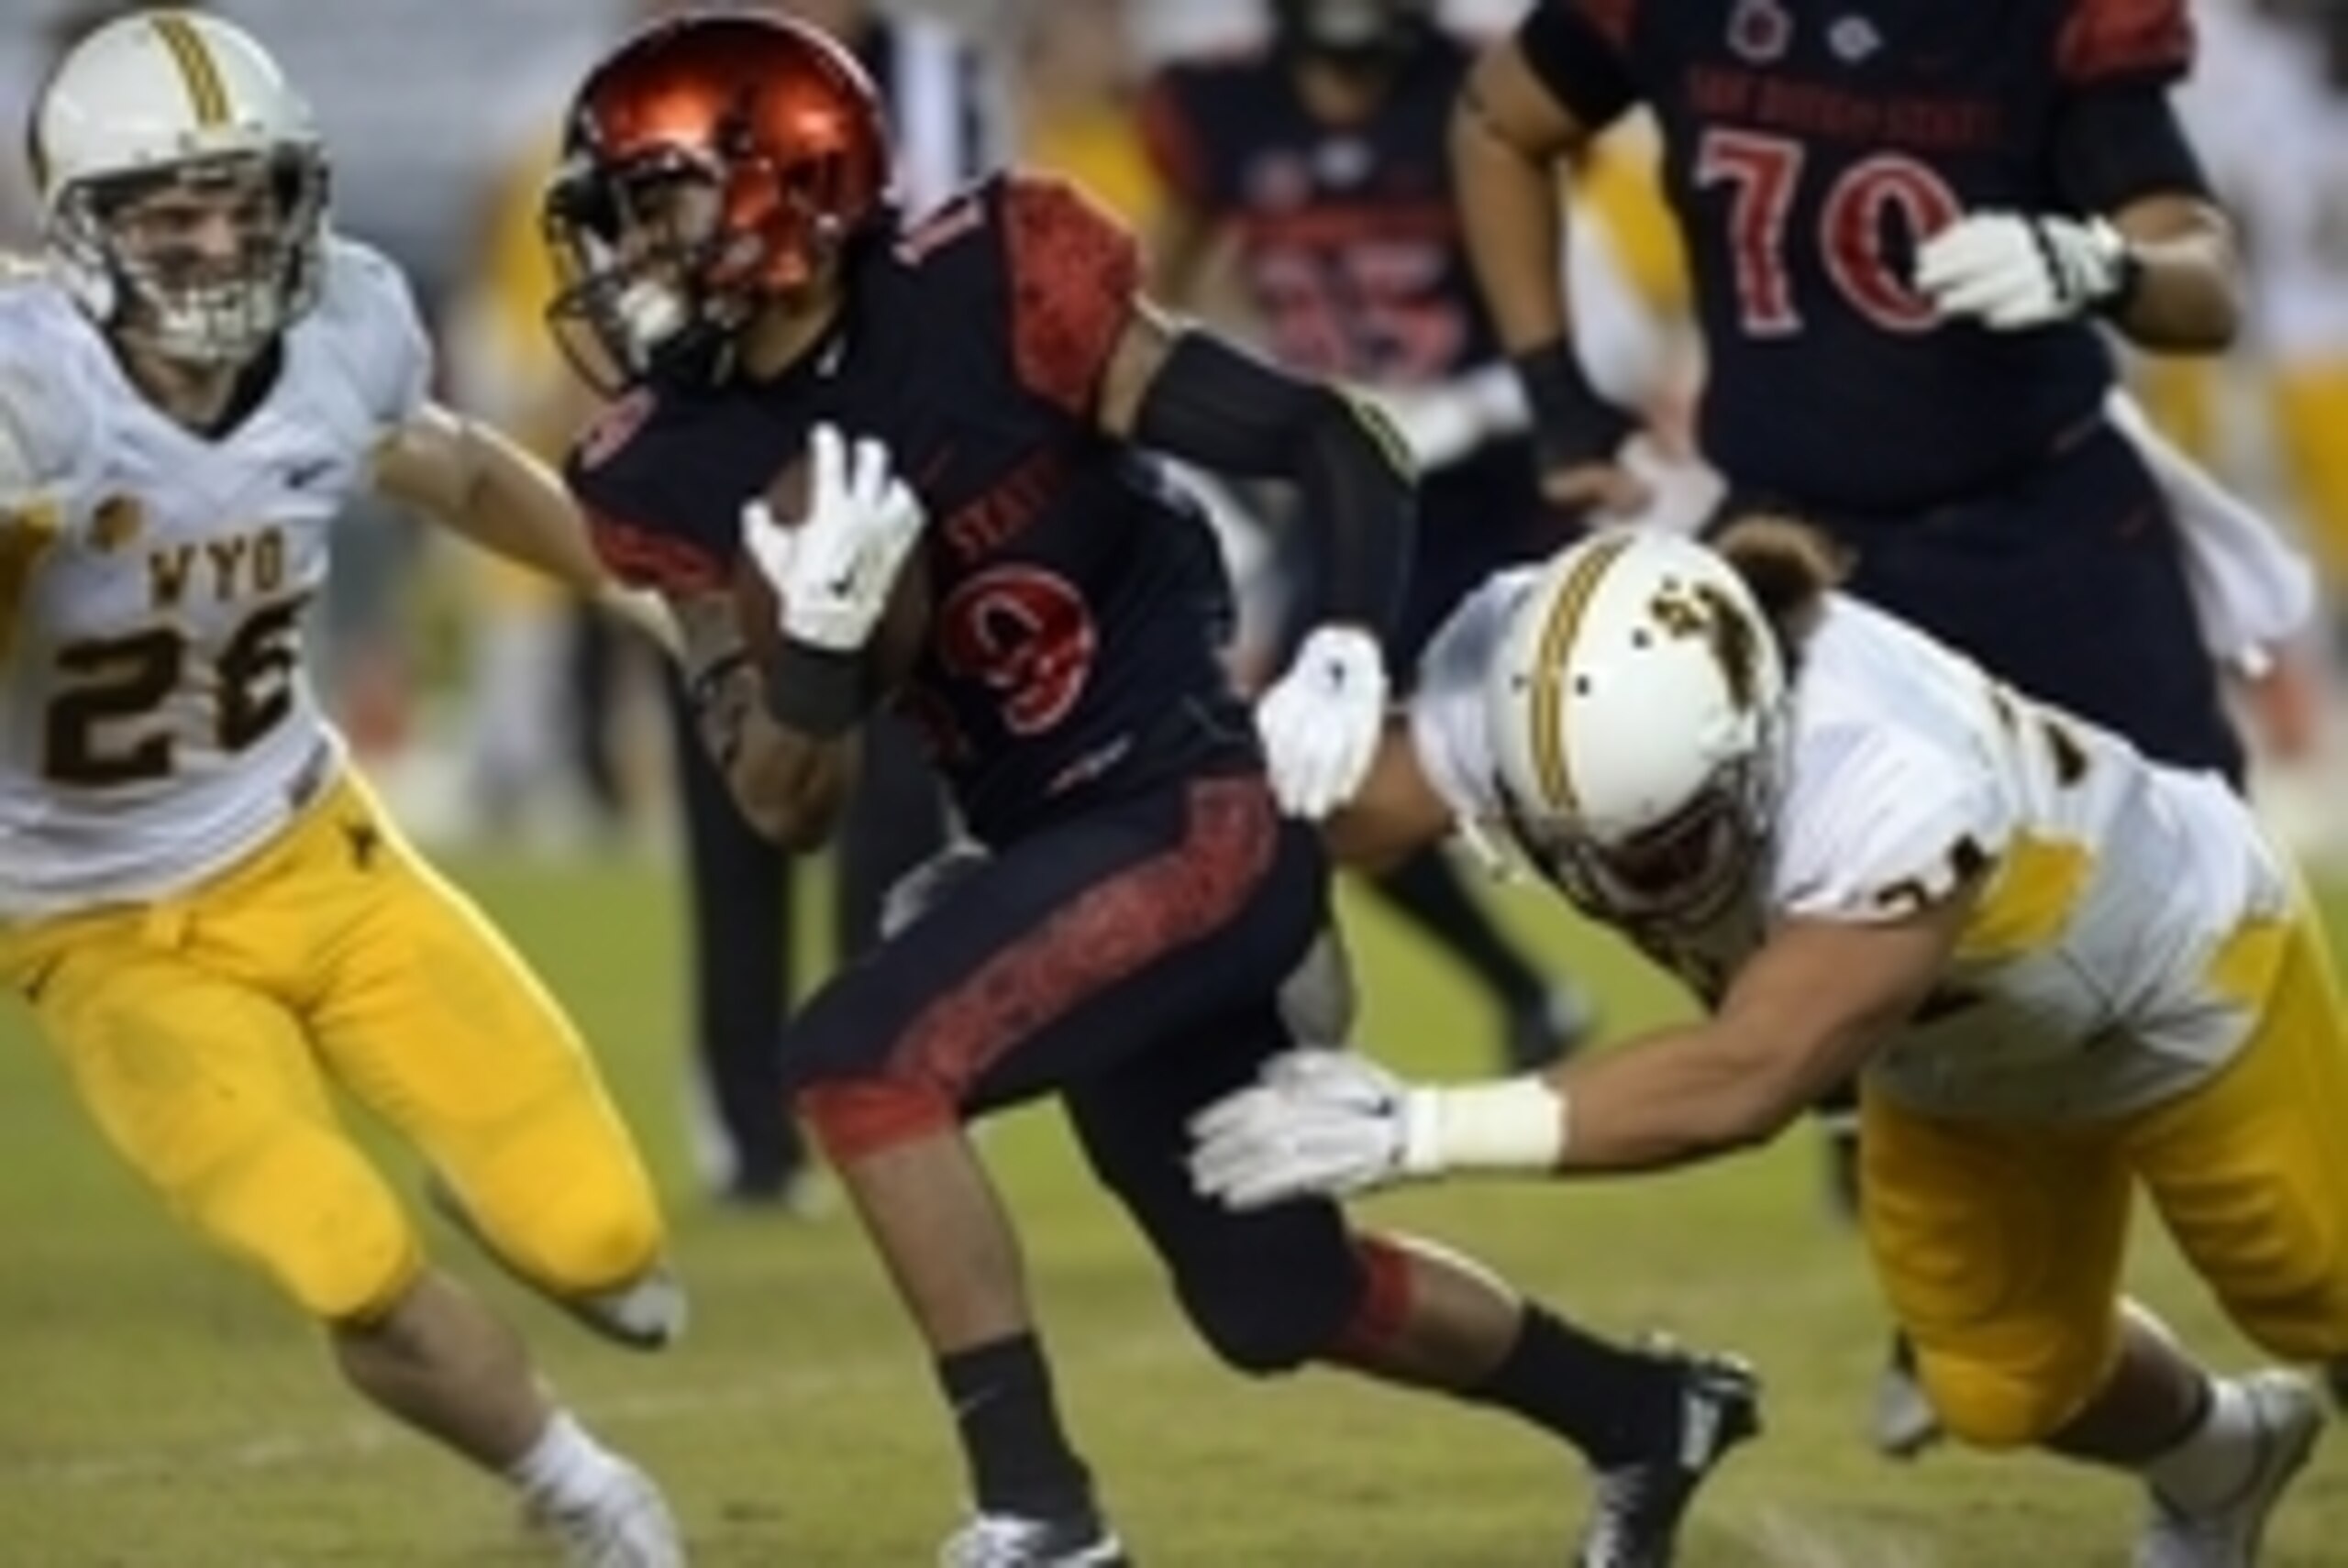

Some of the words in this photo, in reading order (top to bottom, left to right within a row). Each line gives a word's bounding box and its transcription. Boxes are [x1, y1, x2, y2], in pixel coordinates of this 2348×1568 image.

[1695, 124, 1965, 336] 70
[148, 525, 286, 603] WYO
[42, 589, 316, 789] 26
